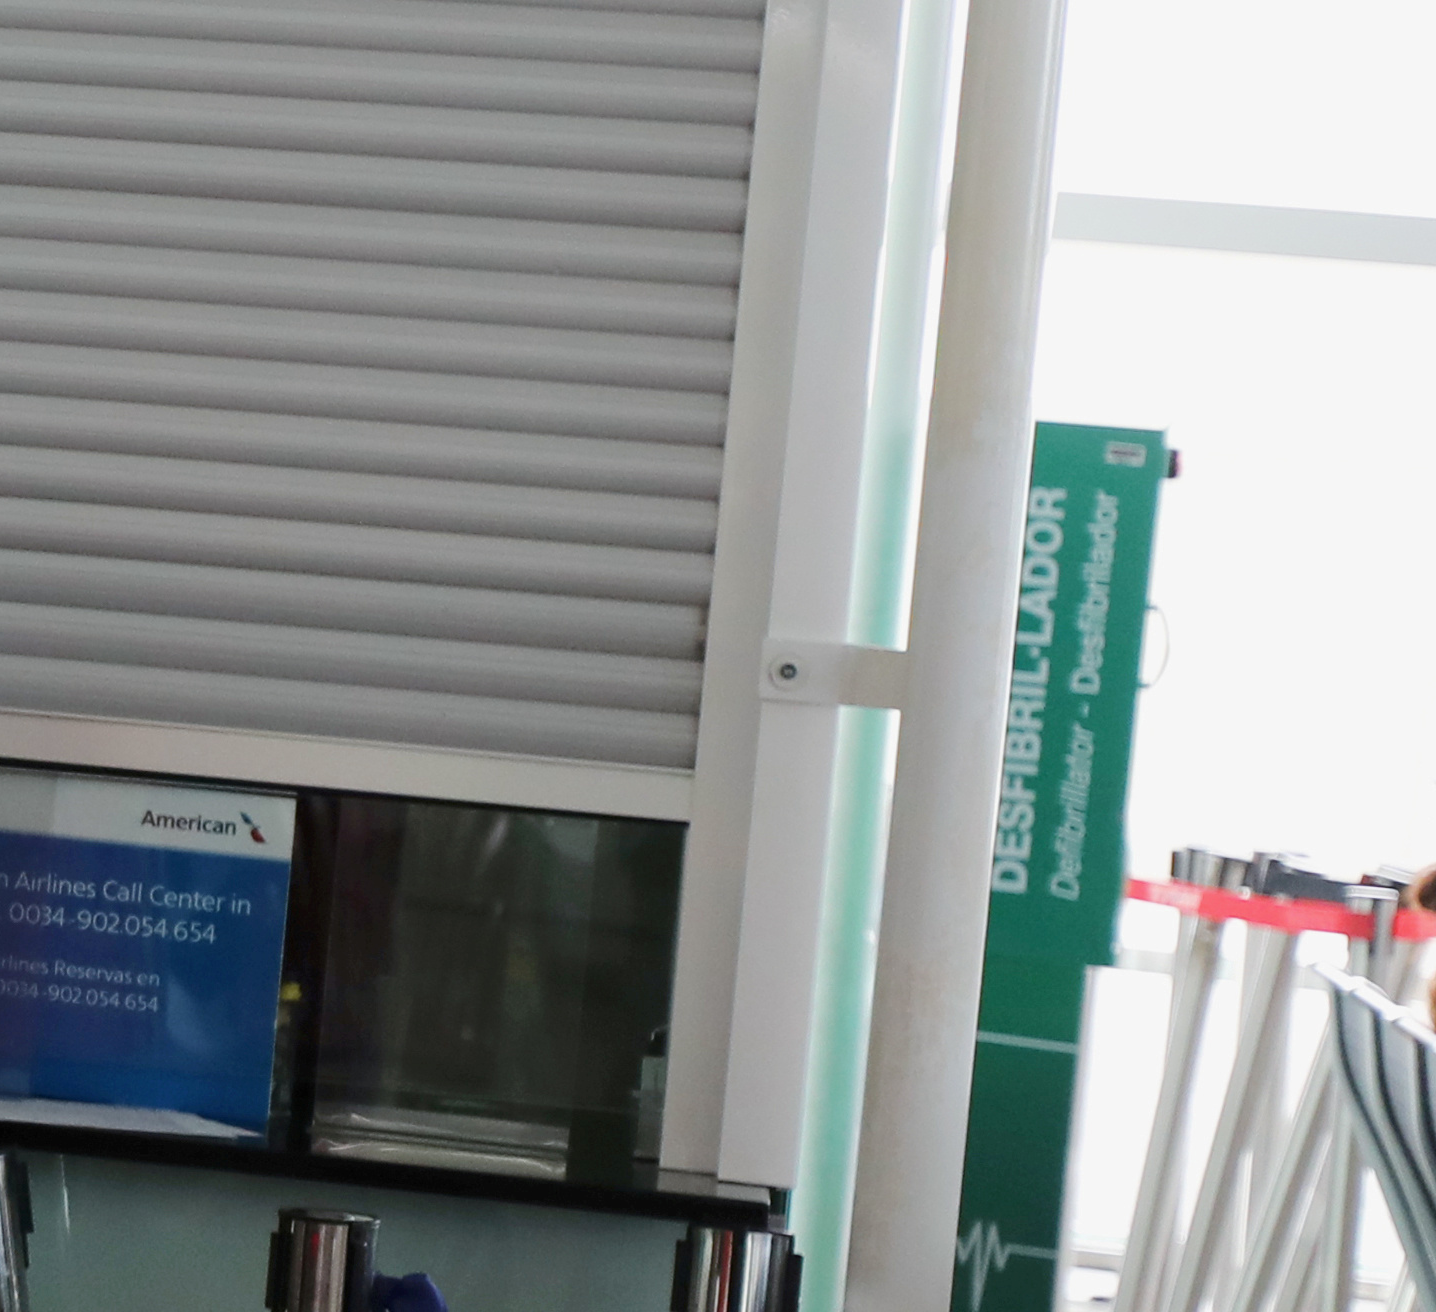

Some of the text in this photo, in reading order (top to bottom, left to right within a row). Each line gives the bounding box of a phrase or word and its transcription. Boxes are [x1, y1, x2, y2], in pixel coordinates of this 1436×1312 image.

[141, 809, 238, 836] American
[14, 870, 97, 900] Airlines
[102, 879, 143, 903] Call
[149, 884, 228, 913] Center
[230, 893, 252, 916] in
[53, 959, 133, 985] Reservas
[136, 972, 161, 987] en
